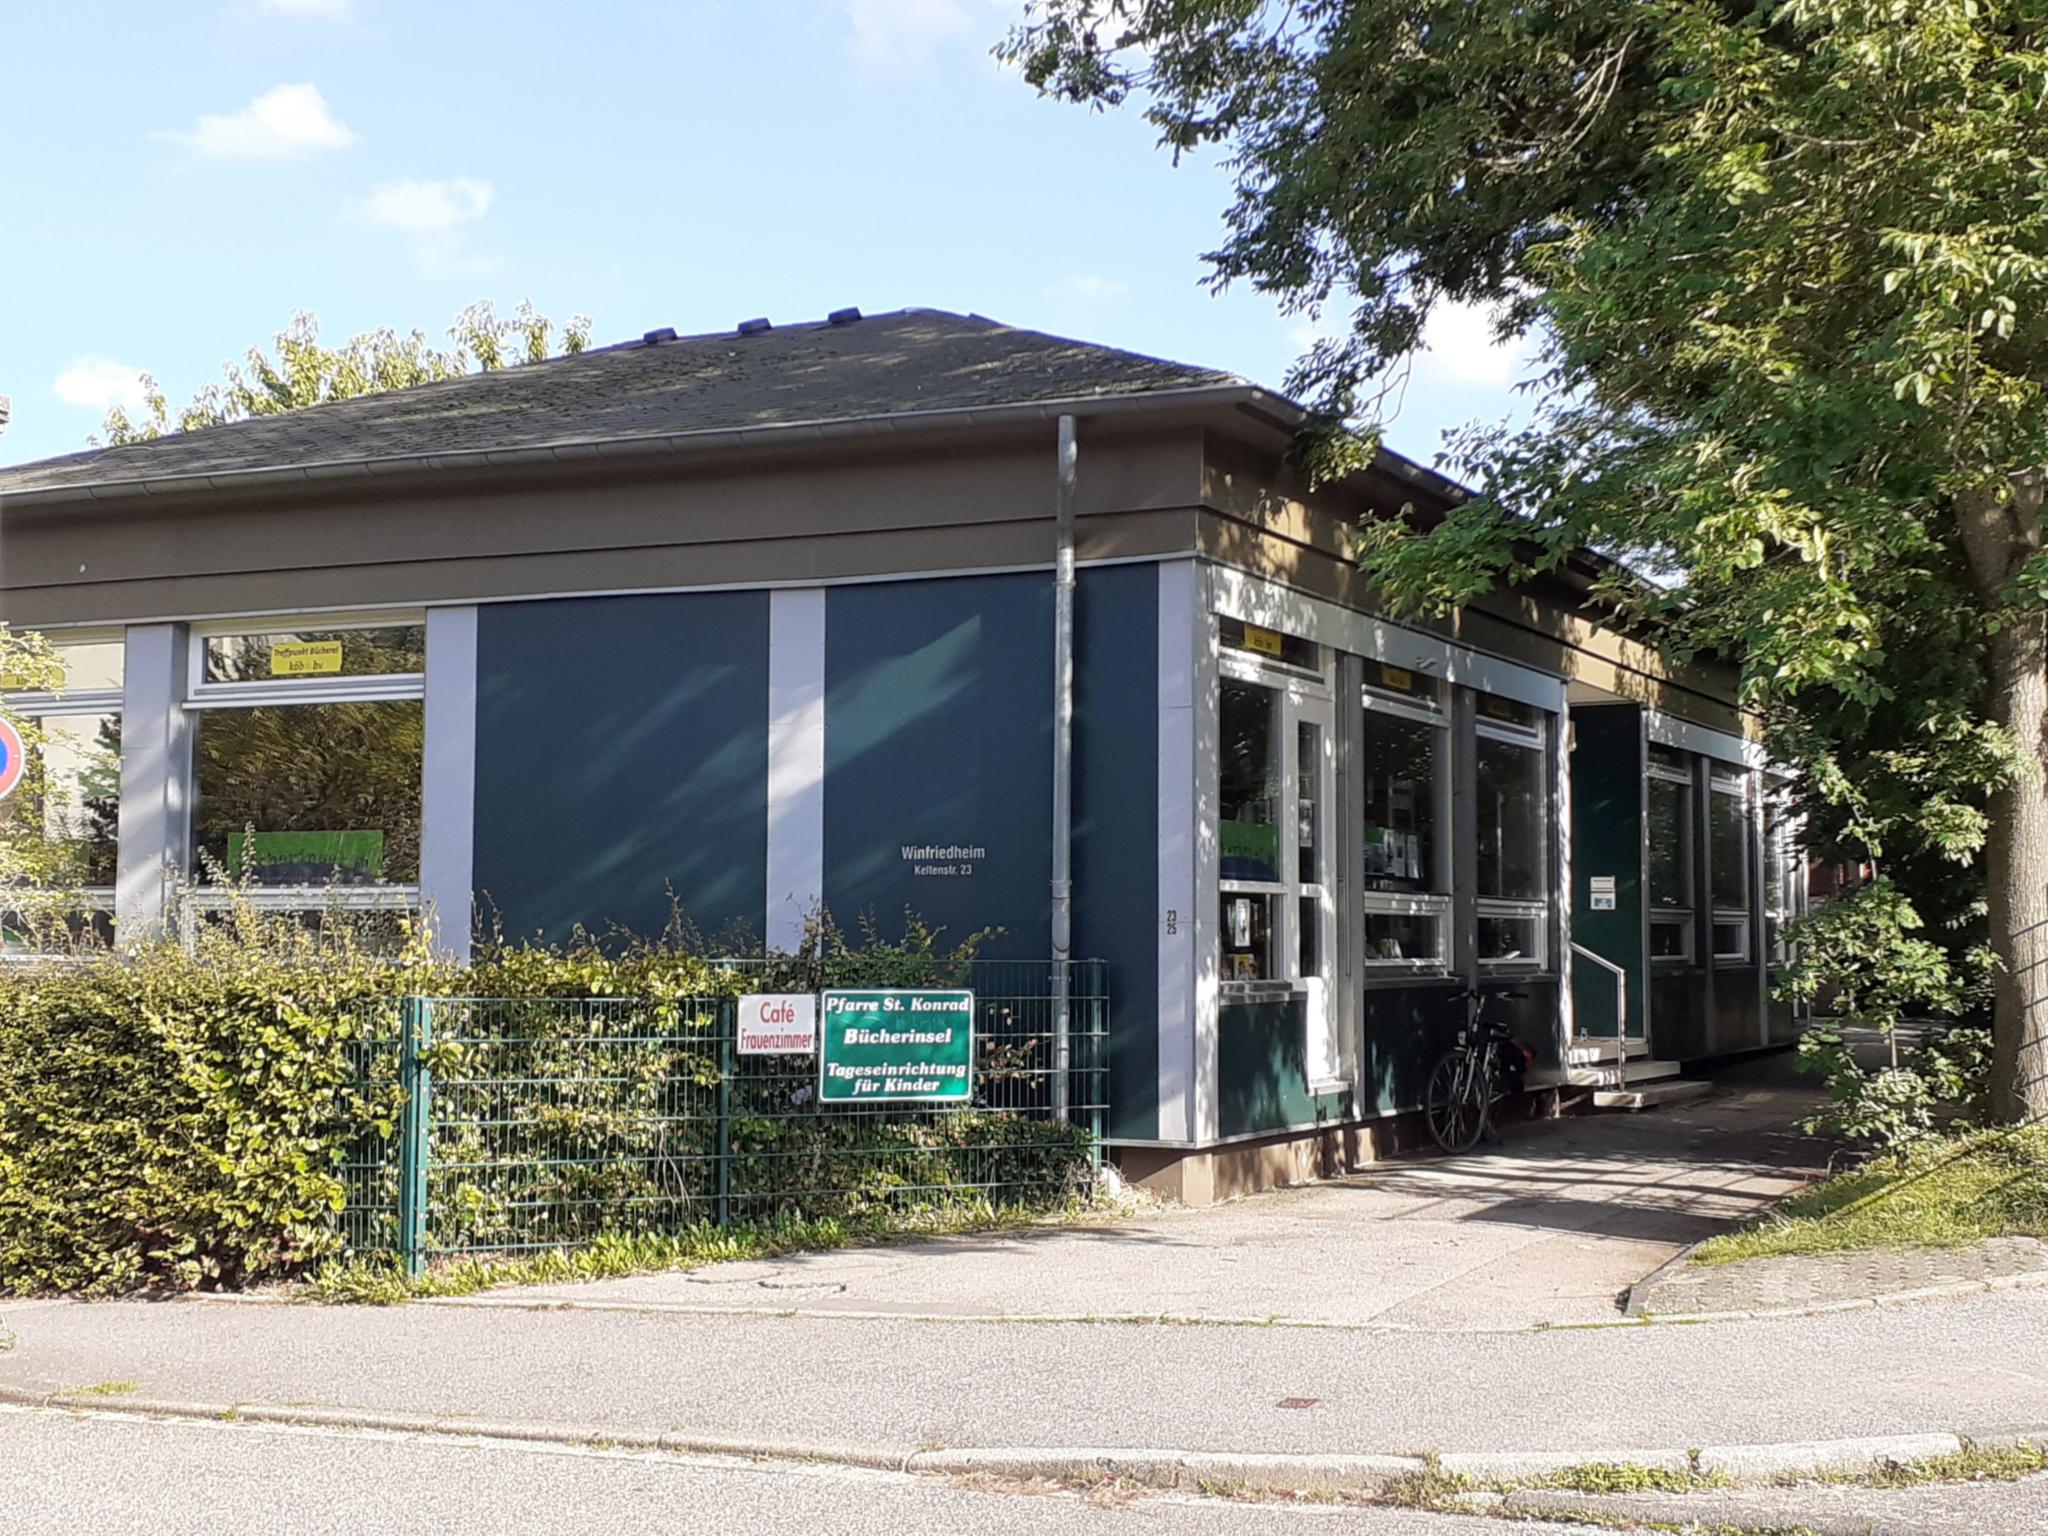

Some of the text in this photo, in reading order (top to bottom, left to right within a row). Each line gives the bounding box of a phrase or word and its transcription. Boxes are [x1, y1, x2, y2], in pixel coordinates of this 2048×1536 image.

[901, 845, 985, 860] Winfriedheim
[960, 864, 972, 875] 23
[1167, 910, 1177, 921] 23
[1167, 923, 1177, 935] 25
[760, 1000, 795, 1023] Café
[826, 997, 969, 1014] Pfarre St. Konrad
[741, 1027, 812, 1049] Frauenzimmer
[844, 1028, 952, 1044] Bücherinsel
[827, 1062, 967, 1079] Tageseinrichtung
[851, 1078, 940, 1095] für Kinder
